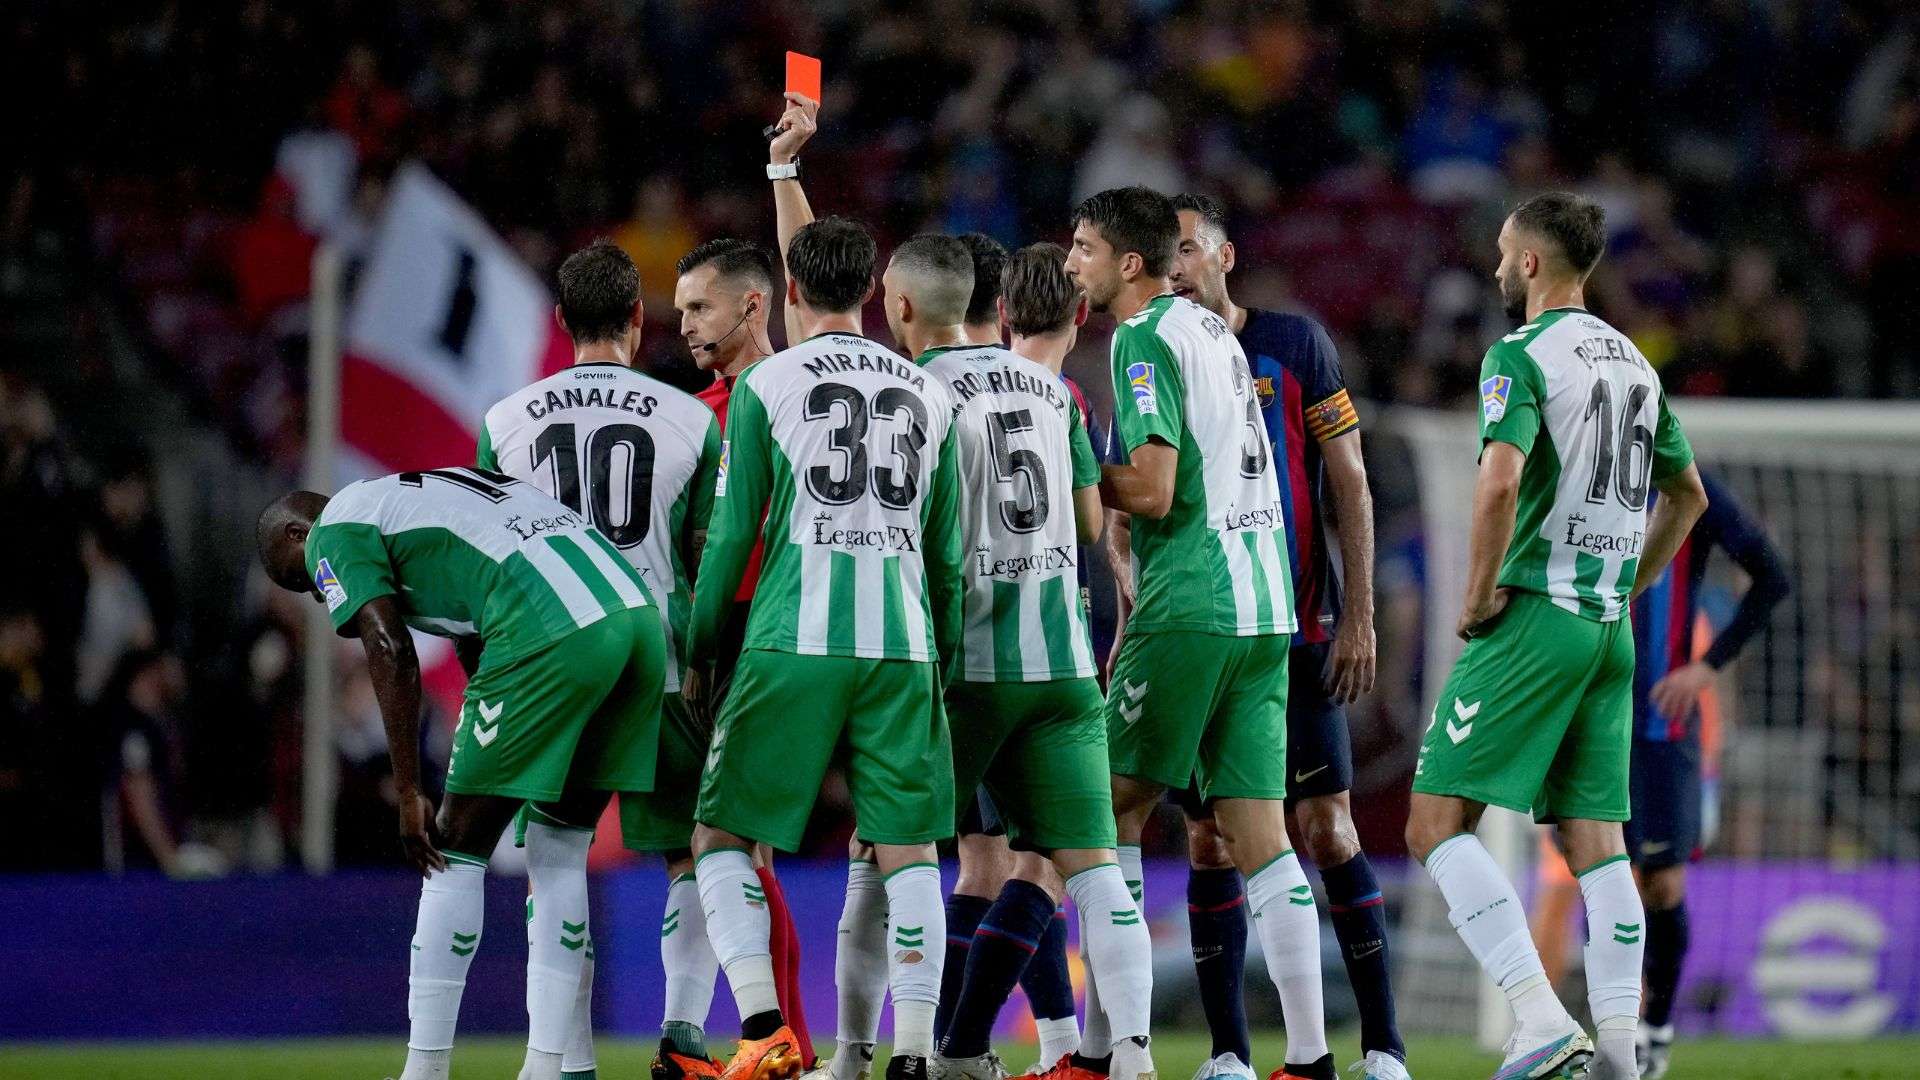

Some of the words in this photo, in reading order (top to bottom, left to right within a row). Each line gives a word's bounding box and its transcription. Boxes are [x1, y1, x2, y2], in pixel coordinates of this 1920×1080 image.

[525, 387, 658, 421] CANALES
[803, 353, 927, 394] MIRANDA
[529, 423, 656, 550] 10
[803, 382, 929, 511] 33
[985, 408, 1049, 535] 5
[1585, 378, 1654, 512] 16
[813, 520, 918, 552] LegacyFX
[976, 545, 1076, 579] LegacyFX
